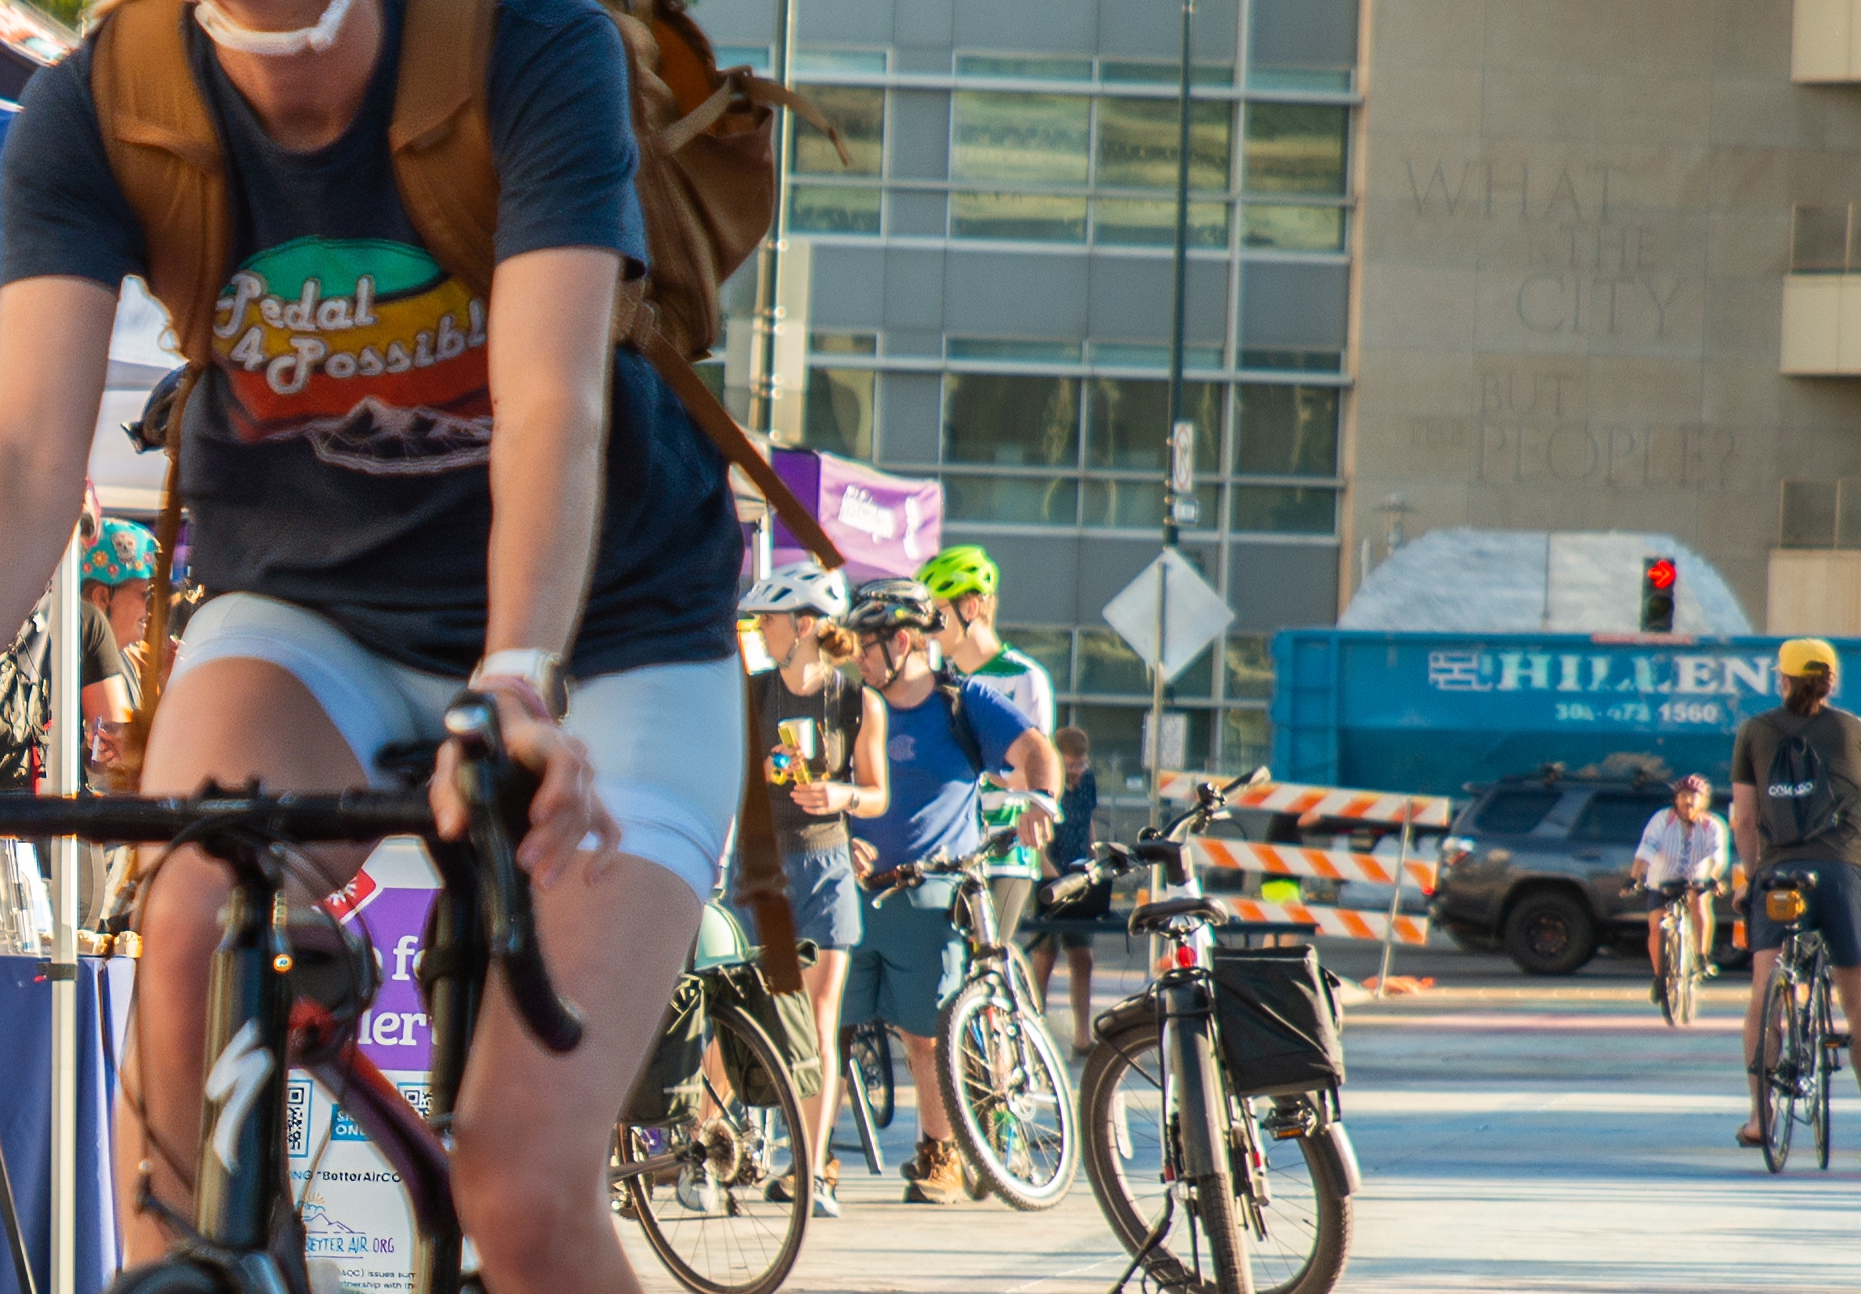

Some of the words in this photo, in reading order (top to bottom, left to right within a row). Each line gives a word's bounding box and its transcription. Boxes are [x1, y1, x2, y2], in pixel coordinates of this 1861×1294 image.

[1401, 160, 1630, 225] WHAT
[1561, 223, 1655, 271] THE
[214, 271, 377, 337] Pedal
[1515, 274, 1680, 338] CITY
[233, 324, 267, 372] 4
[267, 298, 487, 396] Possibl
[1481, 371, 1573, 418] BUT
[1469, 419, 1737, 489] PEOPLE?
